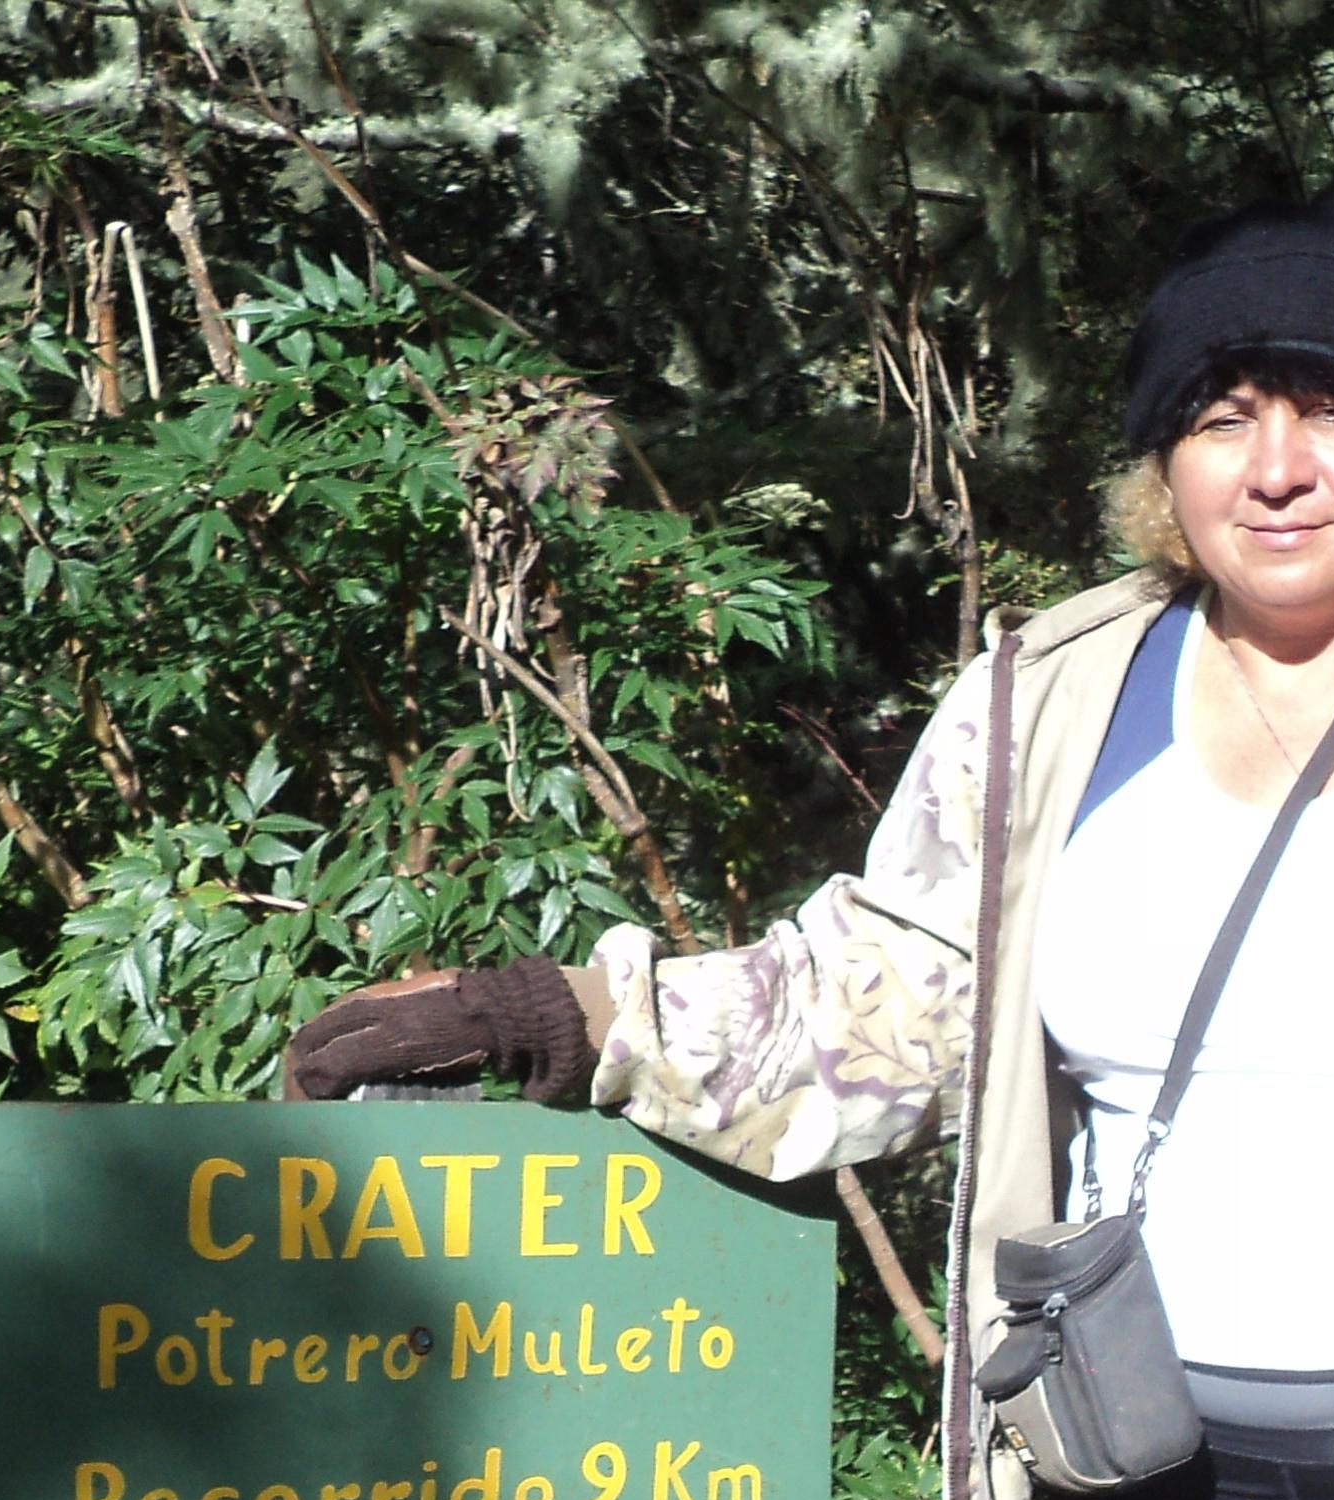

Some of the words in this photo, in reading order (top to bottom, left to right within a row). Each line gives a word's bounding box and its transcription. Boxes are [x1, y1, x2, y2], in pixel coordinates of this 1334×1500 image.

[187, 1153, 664, 1260] CRATER
[97, 1302, 419, 1390] Potrero
[451, 1297, 736, 1380] Muleto
